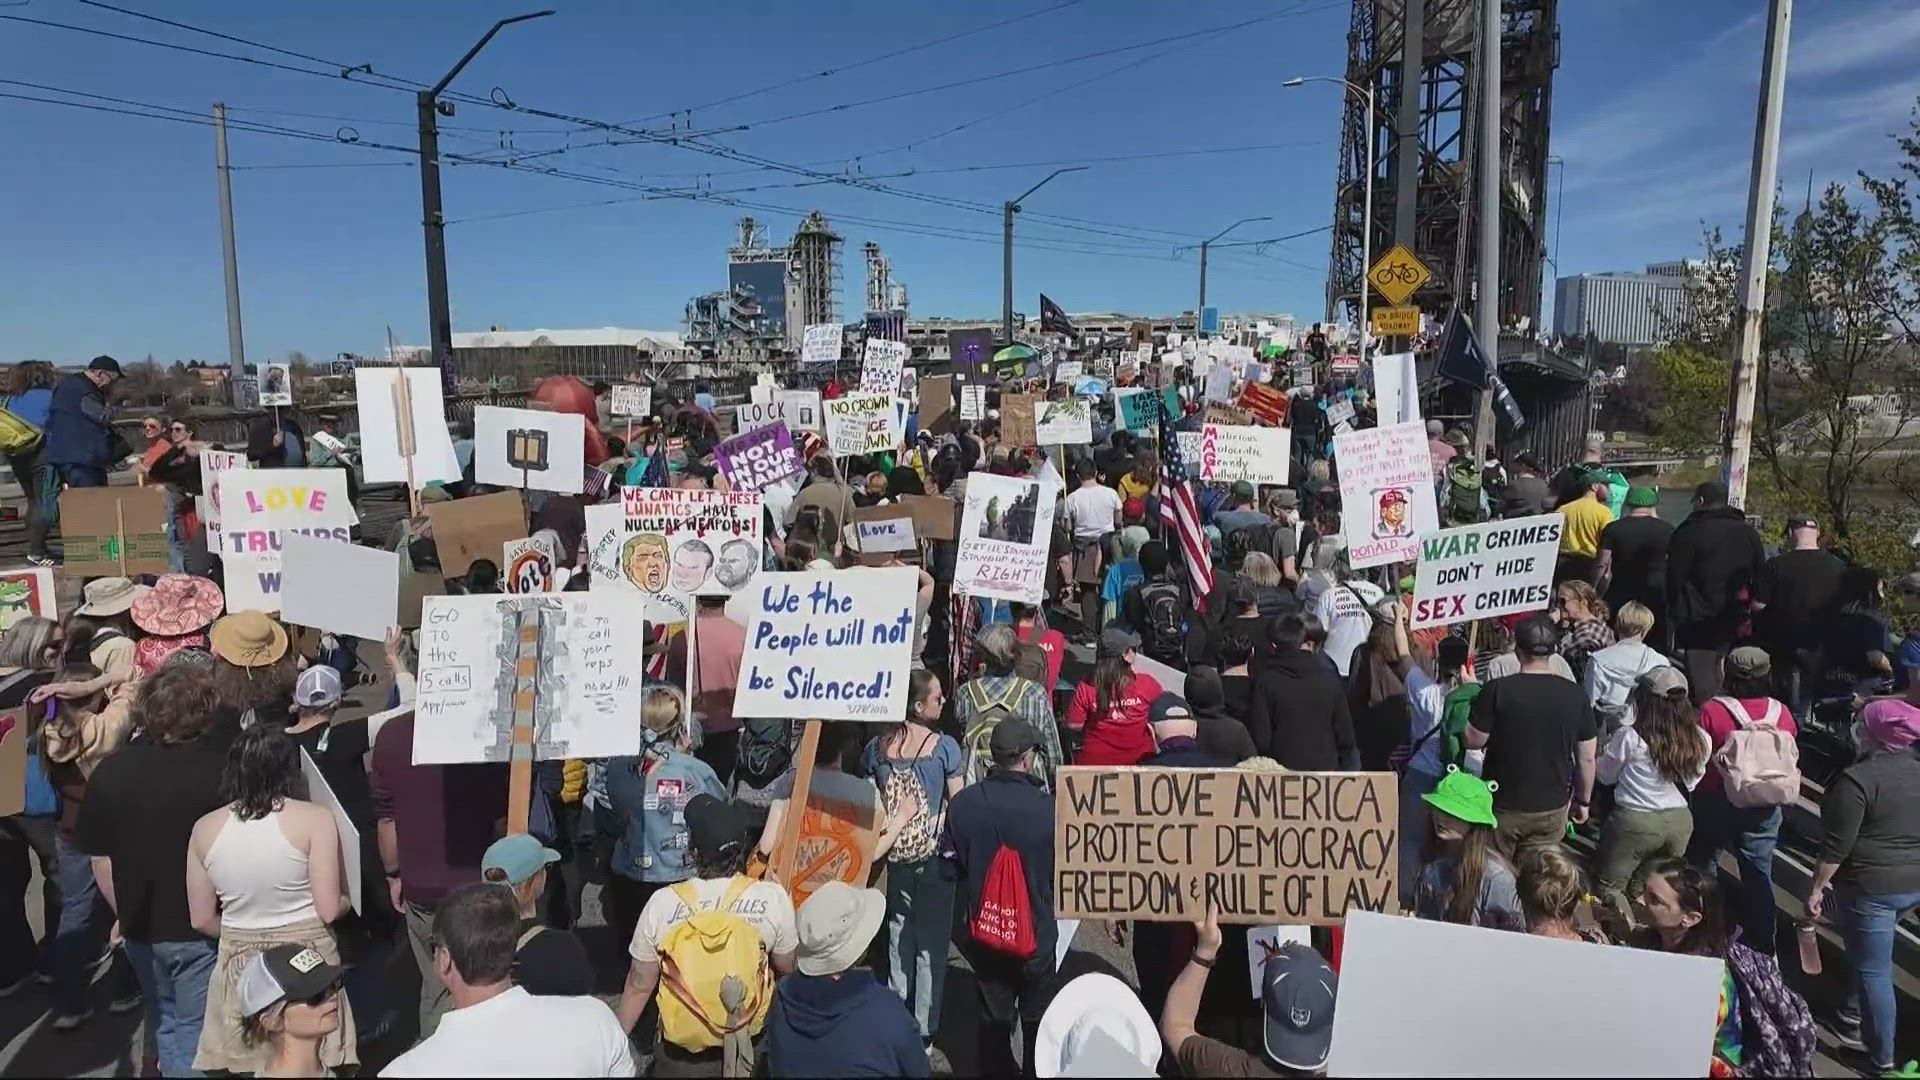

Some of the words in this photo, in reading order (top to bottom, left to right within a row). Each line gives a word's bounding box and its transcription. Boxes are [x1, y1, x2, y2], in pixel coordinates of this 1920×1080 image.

[741, 401, 786, 423] LOCK
[830, 401, 850, 416] NO
[851, 396, 890, 412] CROWN
[729, 439, 775, 470] NOT
[728, 466, 752, 486] IN
[753, 446, 797, 473] OUR
[245, 487, 328, 514] LOVE
[623, 488, 646, 502] WE
[689, 490, 716, 503] LET
[720, 492, 761, 505] THESE
[624, 503, 692, 517] LUNATICS
[703, 504, 739, 518] HAVE
[624, 517, 681, 533] NUCLEAR
[509, 541, 529, 560] SAVE
[533, 539, 551, 555] OUR
[1351, 539, 1399, 559] DONALD
[1422, 533, 1481, 562] WAR
[1485, 524, 1560, 550] CRIMES
[1436, 560, 1484, 586] DON'T
[1495, 557, 1536, 578] HIDE
[762, 583, 800, 614] We
[807, 581, 853, 615] the
[1415, 594, 1467, 622] SEX
[1474, 585, 1549, 610] CRIMES
[428, 607, 460, 624] GO
[429, 629, 450, 643] TO
[588, 627, 611, 640] call
[754, 620, 819, 656] People
[825, 618, 865, 647] will
[872, 608, 913, 645] not
[427, 646, 458, 662] the
[582, 644, 612, 659] your
[585, 659, 614, 675] reps
[424, 673, 434, 689] 5
[438, 672, 468, 686] calls
[749, 665, 774, 690] be
[783, 666, 892, 700] Silenced!
[1065, 773, 1120, 818] WE
[1133, 773, 1216, 818] LOVE
[1233, 773, 1383, 823] AMERICA
[1065, 822, 1199, 866] PROTECT
[1059, 870, 1184, 915] FREEDOM
[1190, 876, 1201, 903] &
[1204, 871, 1276, 916] RULE
[1283, 873, 1316, 918] OF
[1322, 874, 1392, 919] LAW
